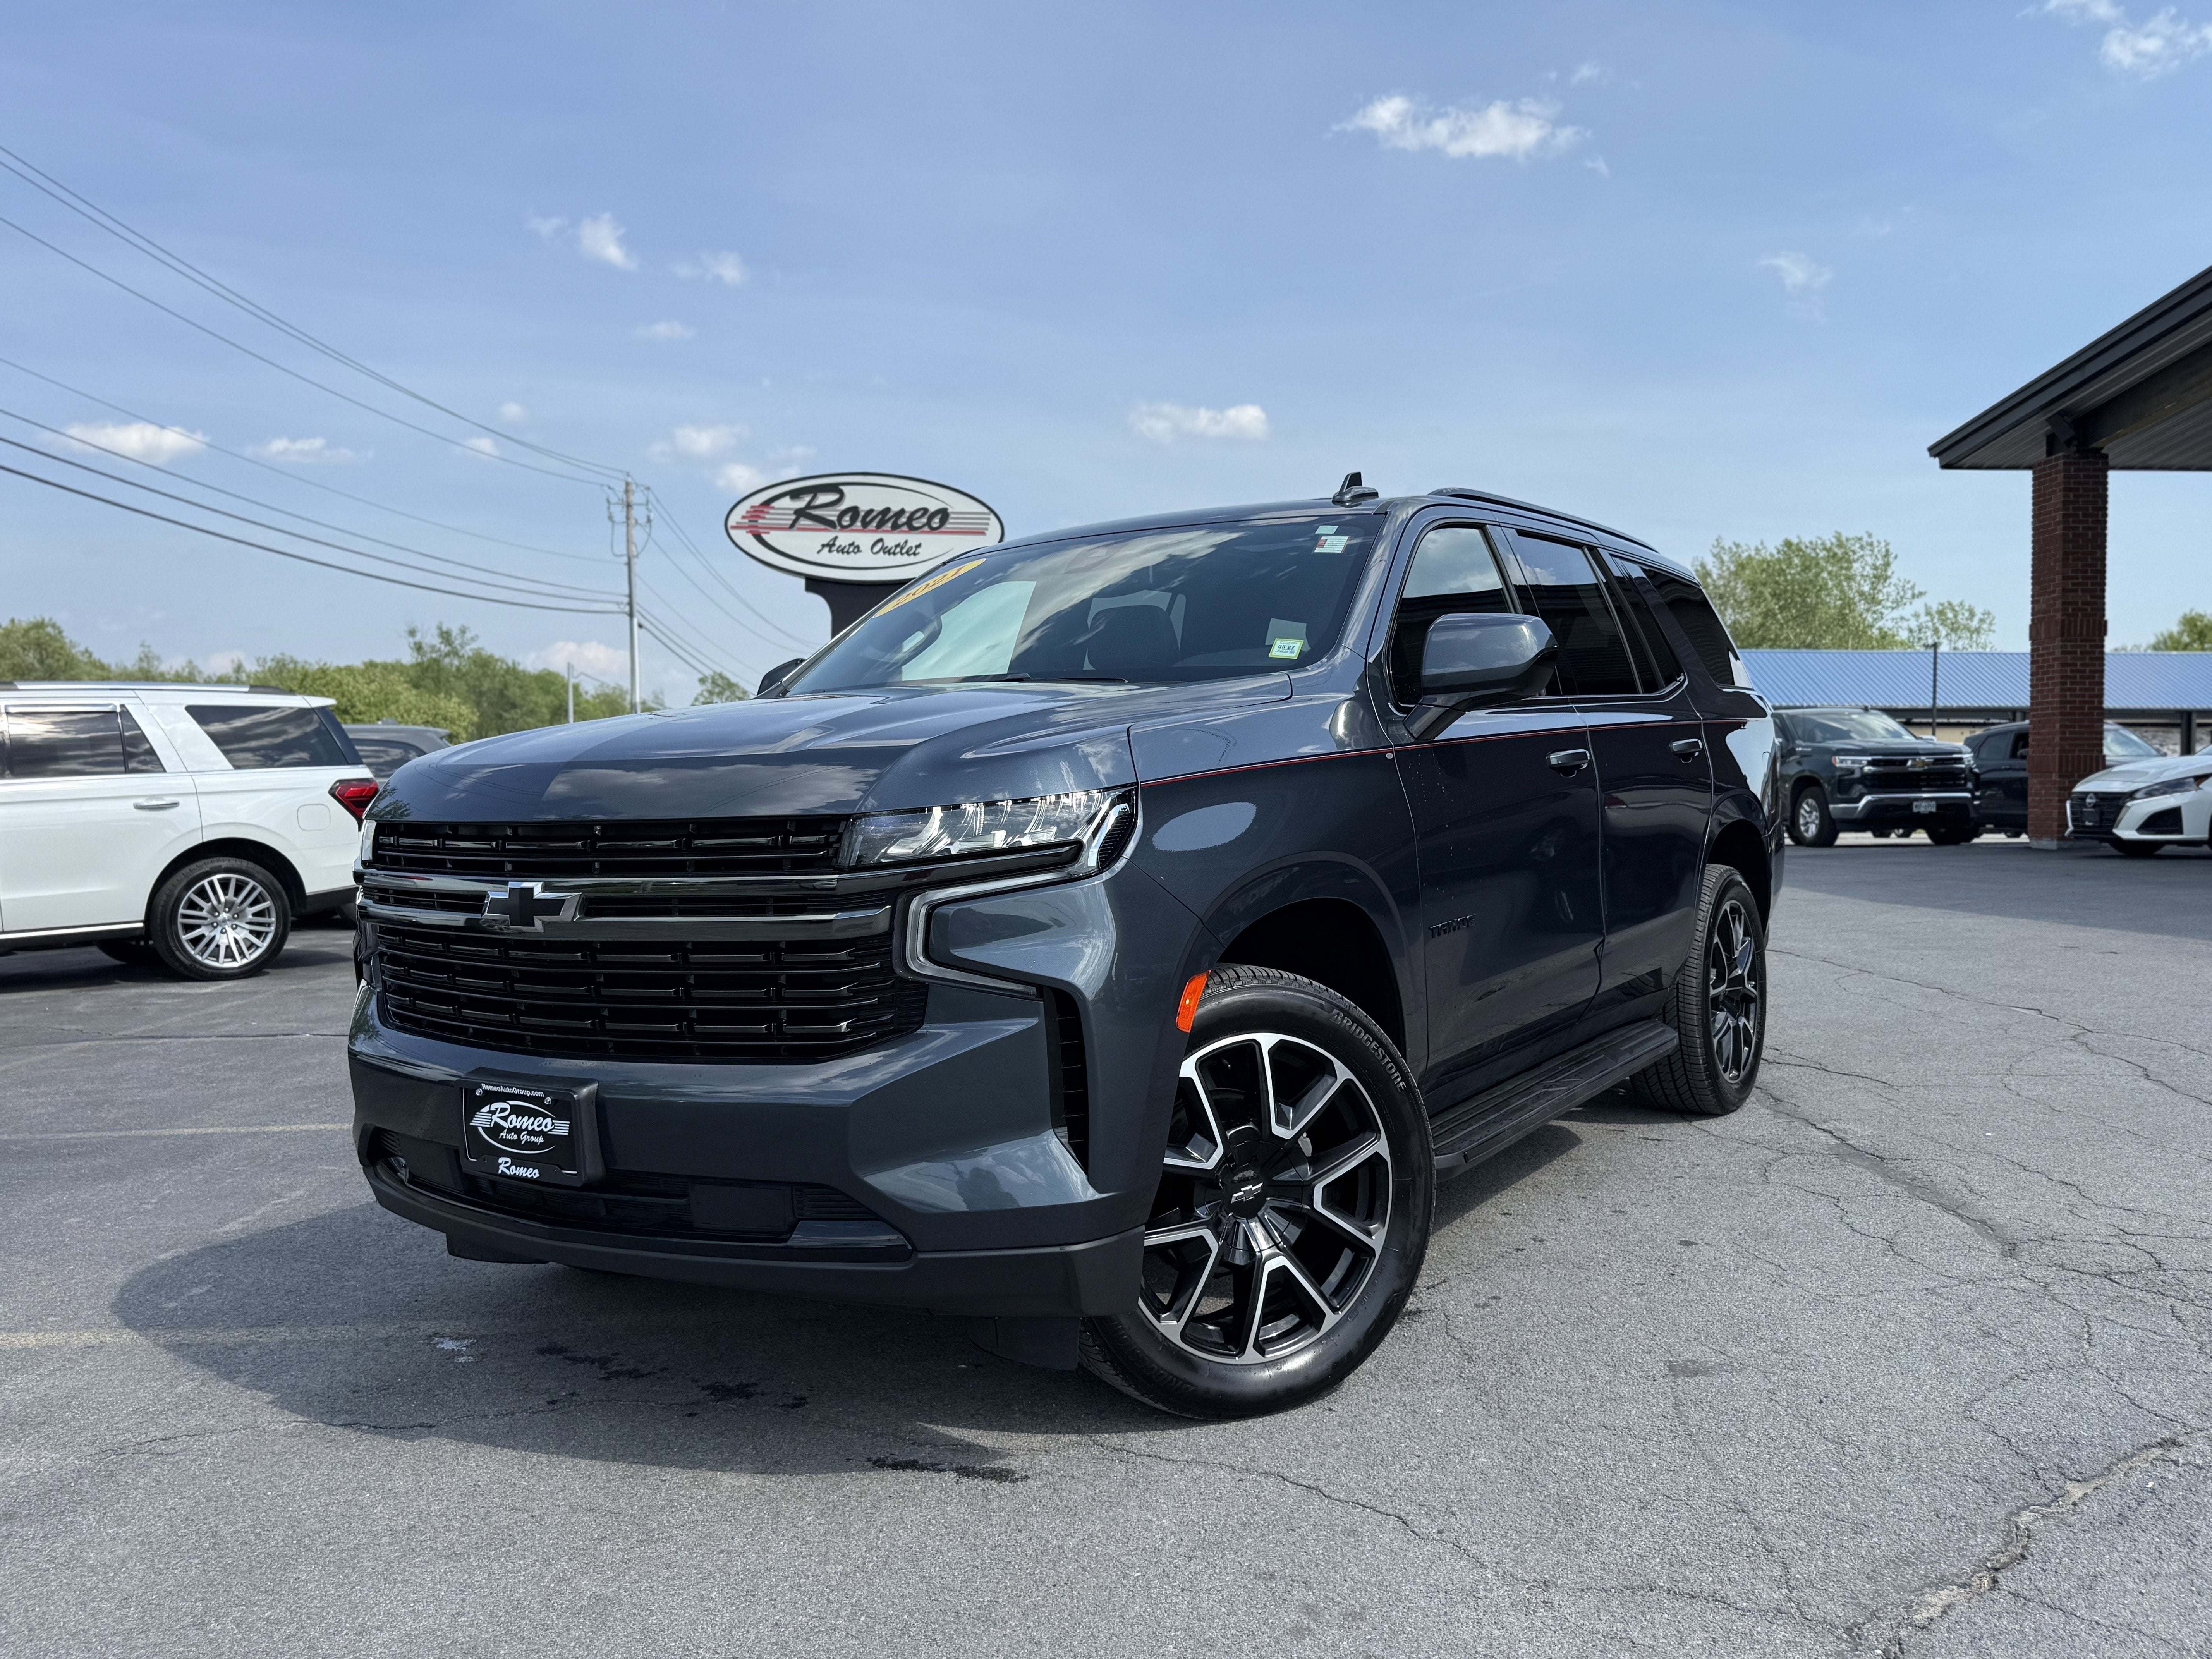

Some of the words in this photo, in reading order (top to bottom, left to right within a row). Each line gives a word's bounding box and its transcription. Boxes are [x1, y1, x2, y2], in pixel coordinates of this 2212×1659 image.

[789, 485, 950, 531] Romeo
[817, 536, 862, 555] Auto
[871, 538, 922, 556] Outlet
[892, 565, 967, 608] 2021
[1329, 1008, 1407, 1092] BRIDGESTONE
[481, 1083, 544, 1097] RomeoAutoGroup.com
[490, 1102, 555, 1132] Romeo
[499, 1129, 518, 1140] Auto
[520, 1131, 544, 1145] Group
[498, 1157, 540, 1178] Romeo
